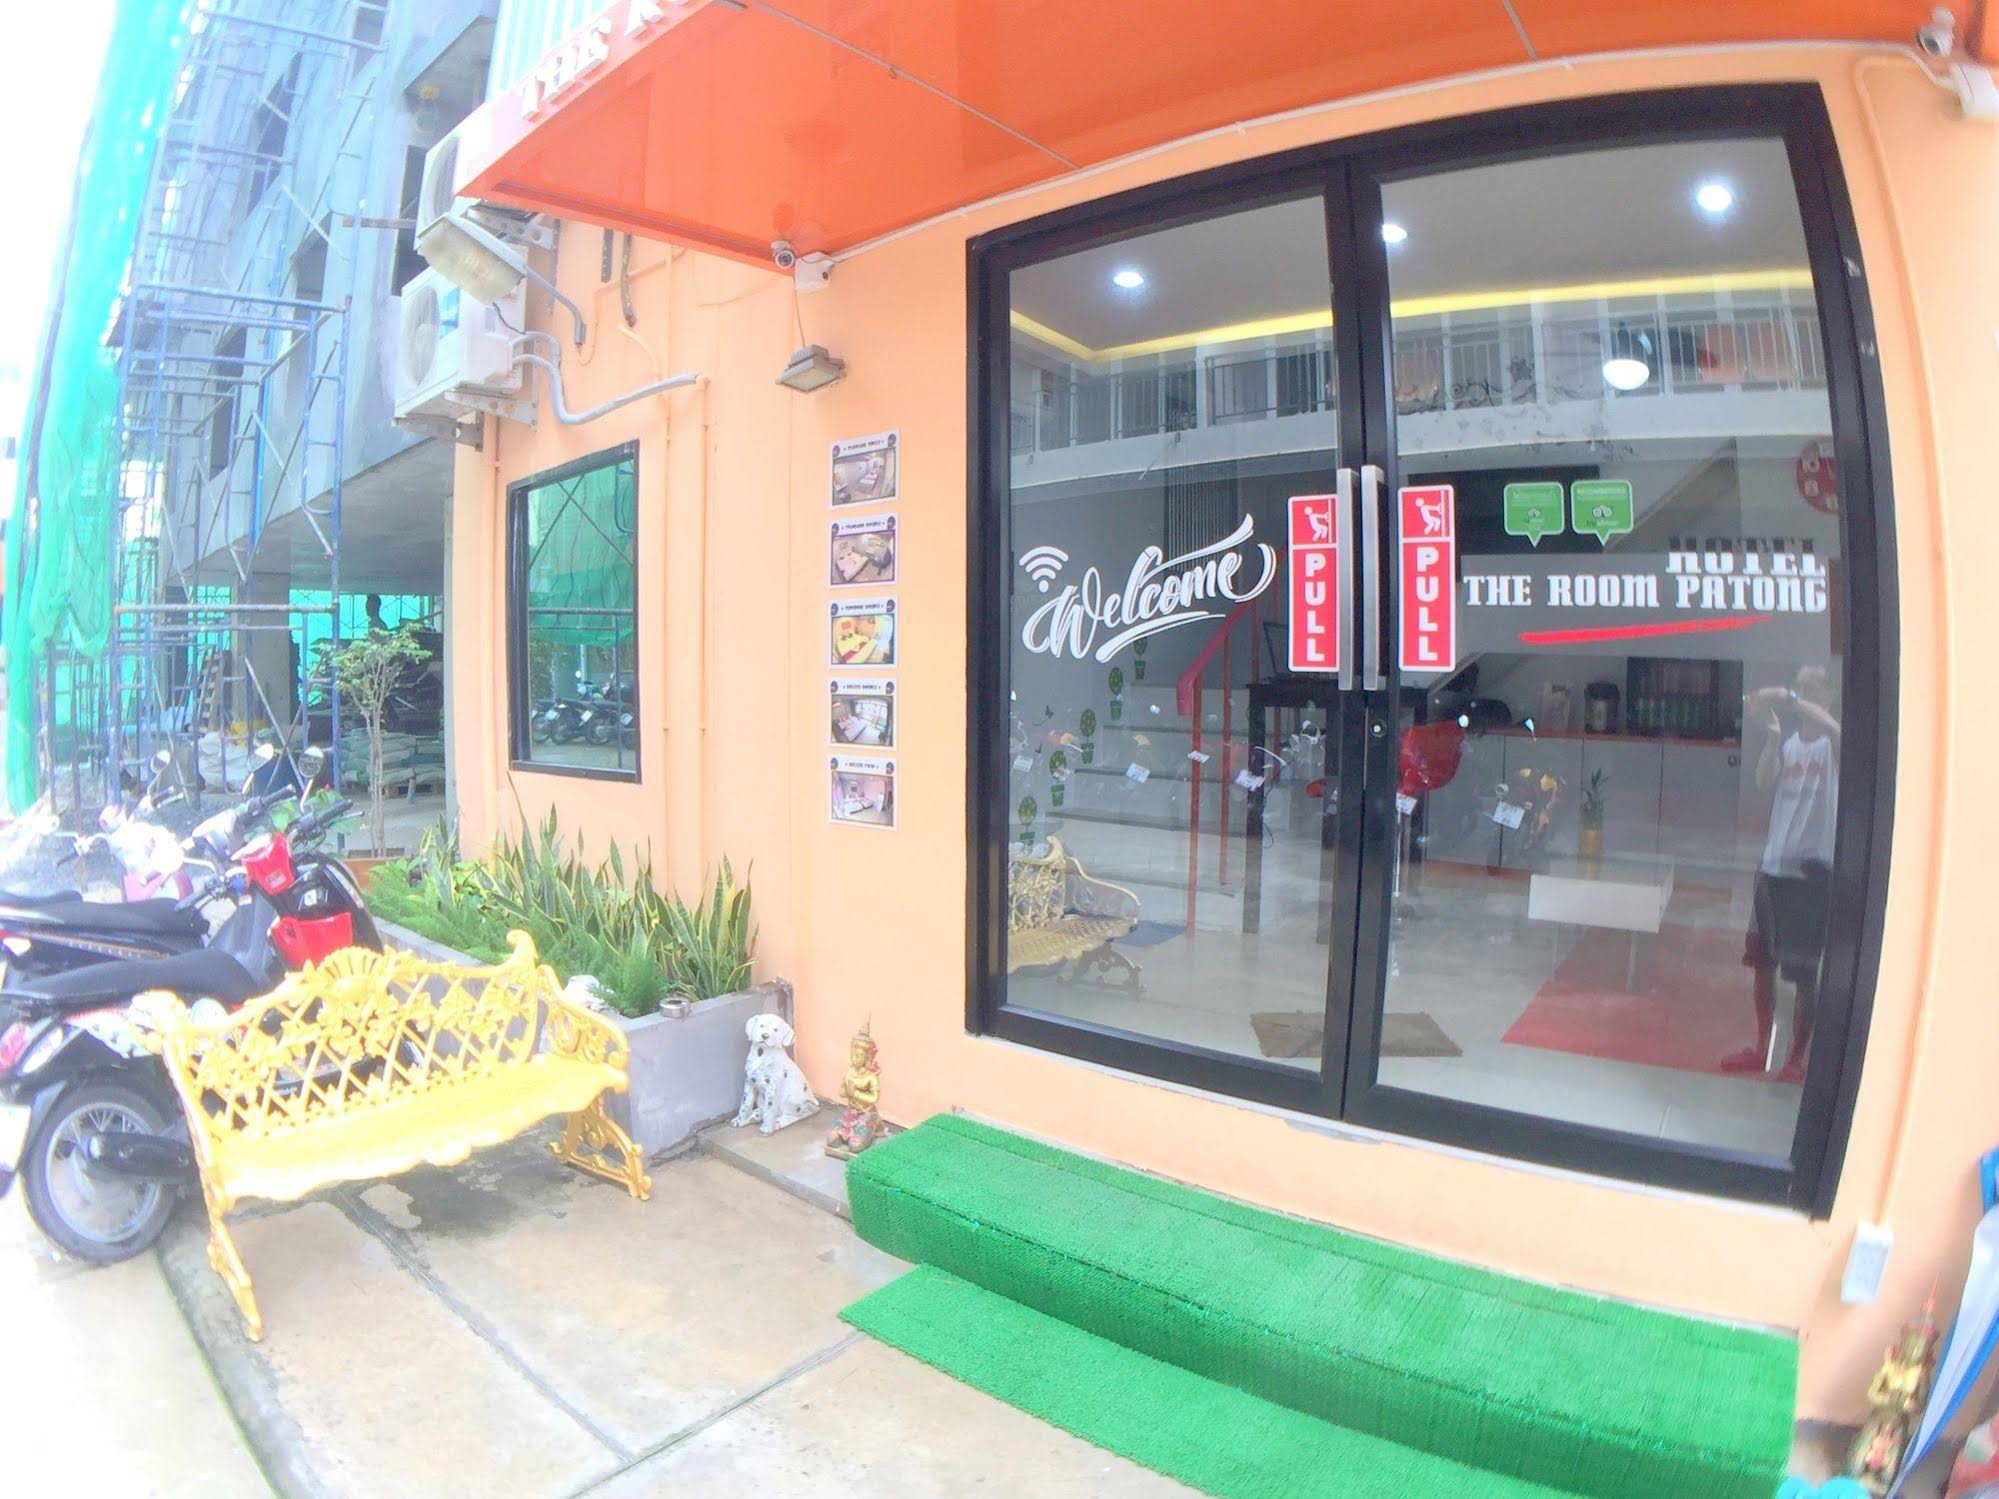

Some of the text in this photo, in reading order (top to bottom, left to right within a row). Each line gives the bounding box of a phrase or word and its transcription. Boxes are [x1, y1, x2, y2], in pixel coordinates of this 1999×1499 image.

[1023, 513, 1277, 662] Welcome
[1305, 552, 1326, 663] PULL
[1416, 546, 1439, 662] PULL
[1462, 574, 1827, 613] THE ROOM PATONG
[1665, 537, 1826, 577] HOTEL
